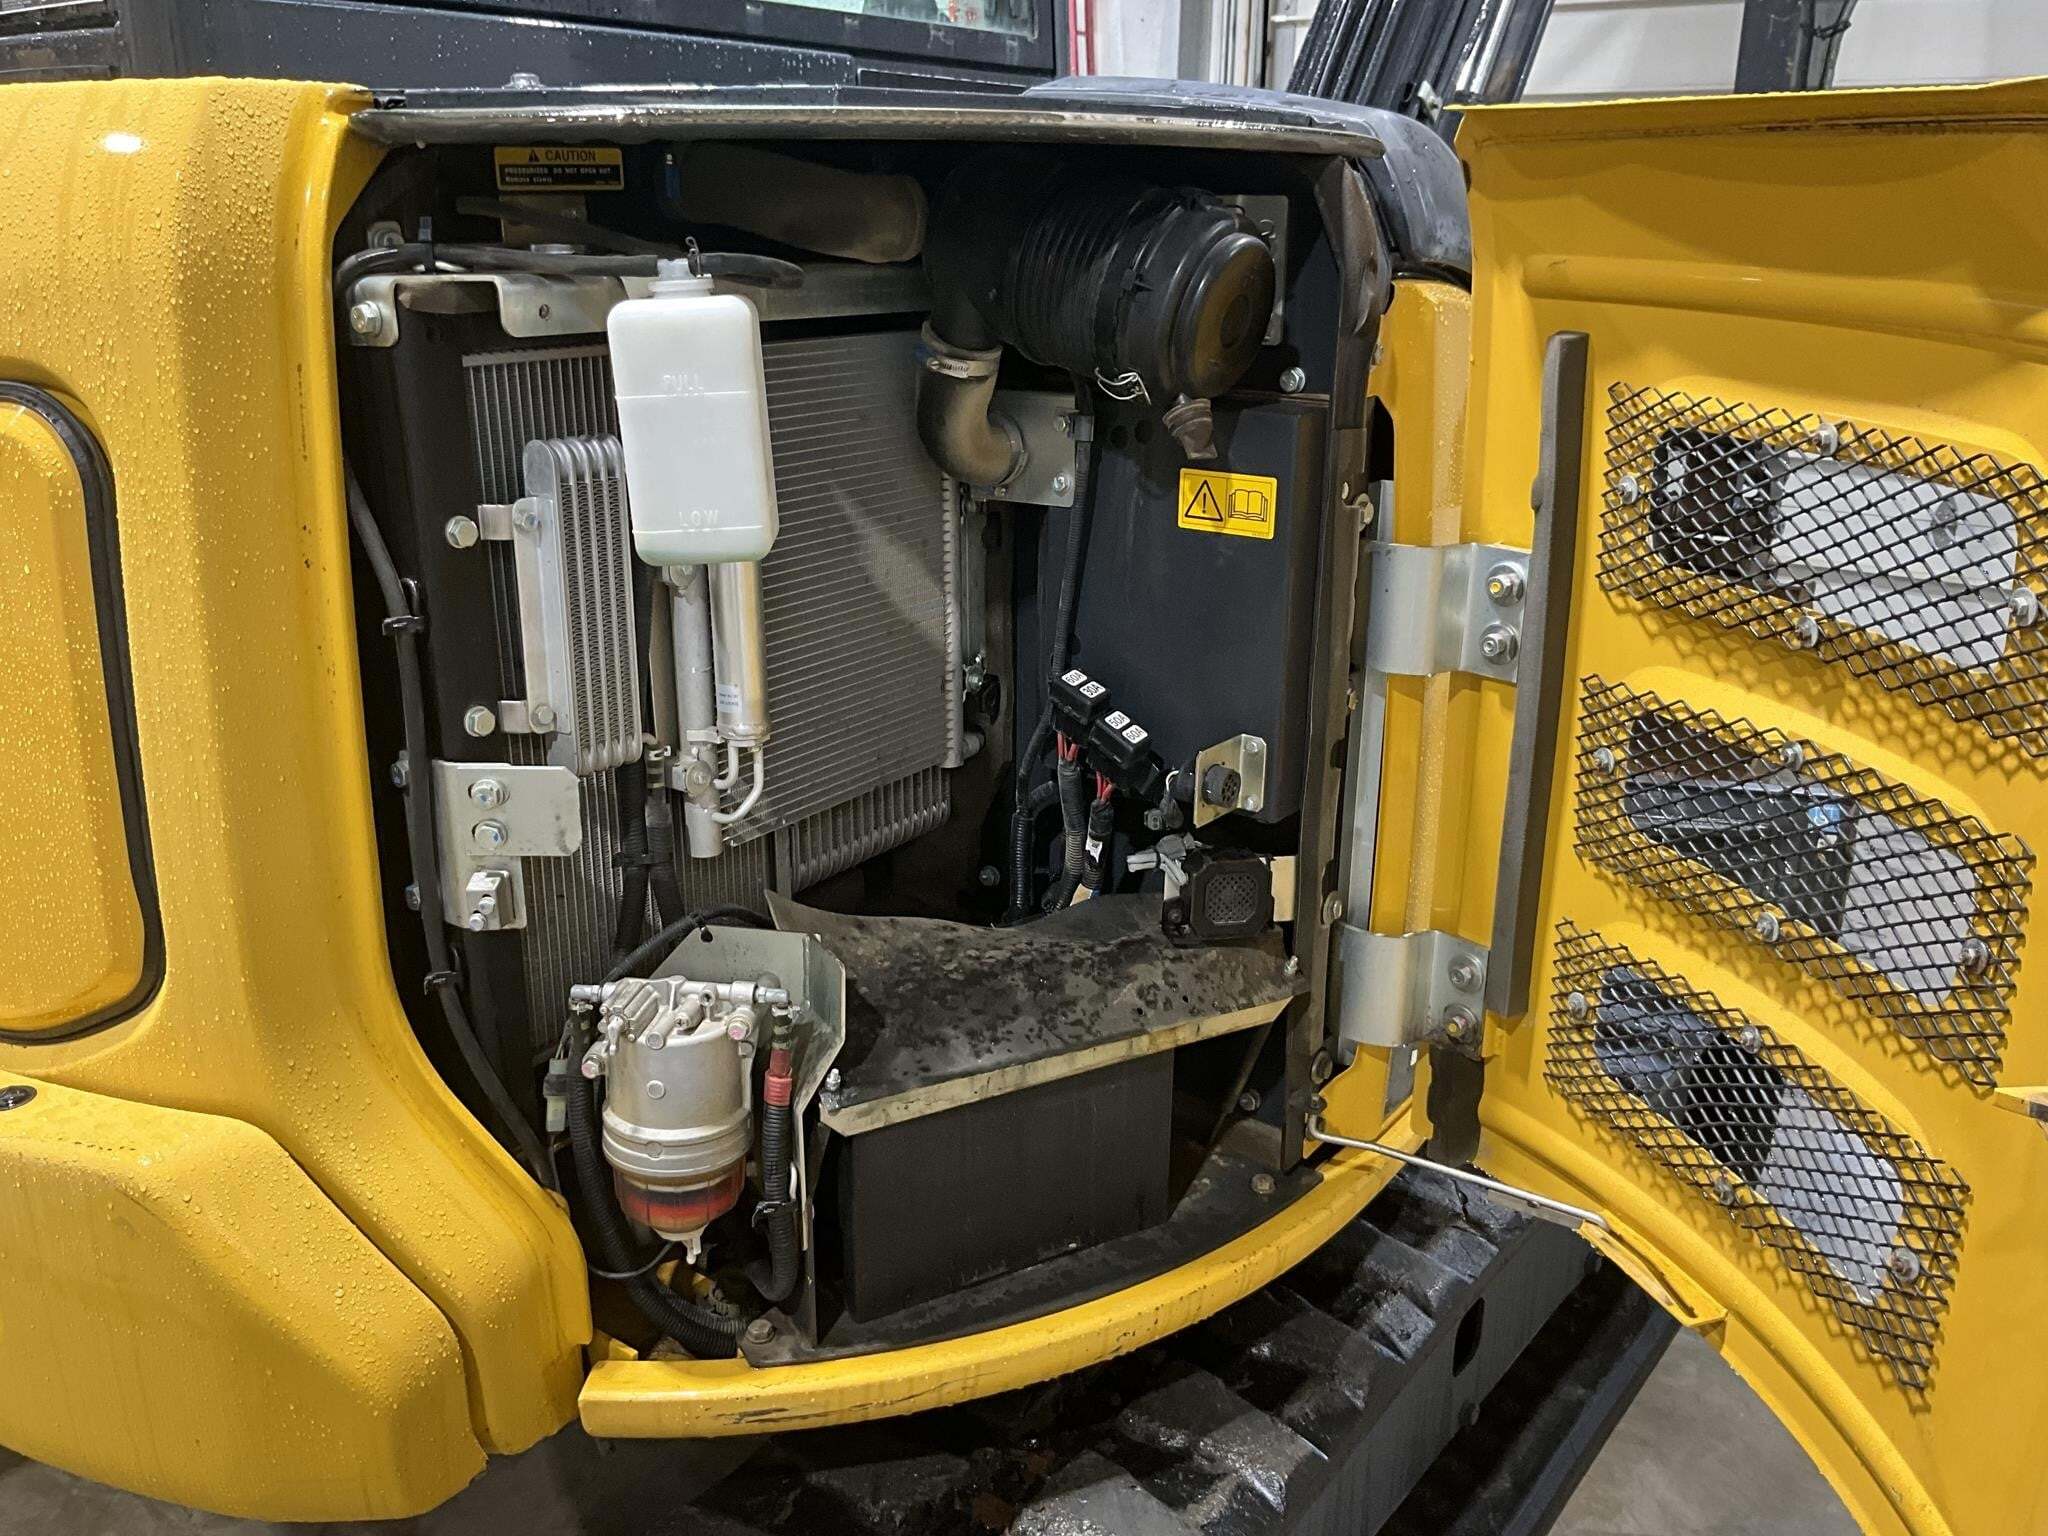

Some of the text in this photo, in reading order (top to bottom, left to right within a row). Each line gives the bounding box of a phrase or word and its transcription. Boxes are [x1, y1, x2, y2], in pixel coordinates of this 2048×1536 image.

[545, 150, 596, 161] CAUTION
[662, 373, 705, 391] FULL
[679, 510, 719, 526] LOW
[1082, 683, 1100, 696] 30A
